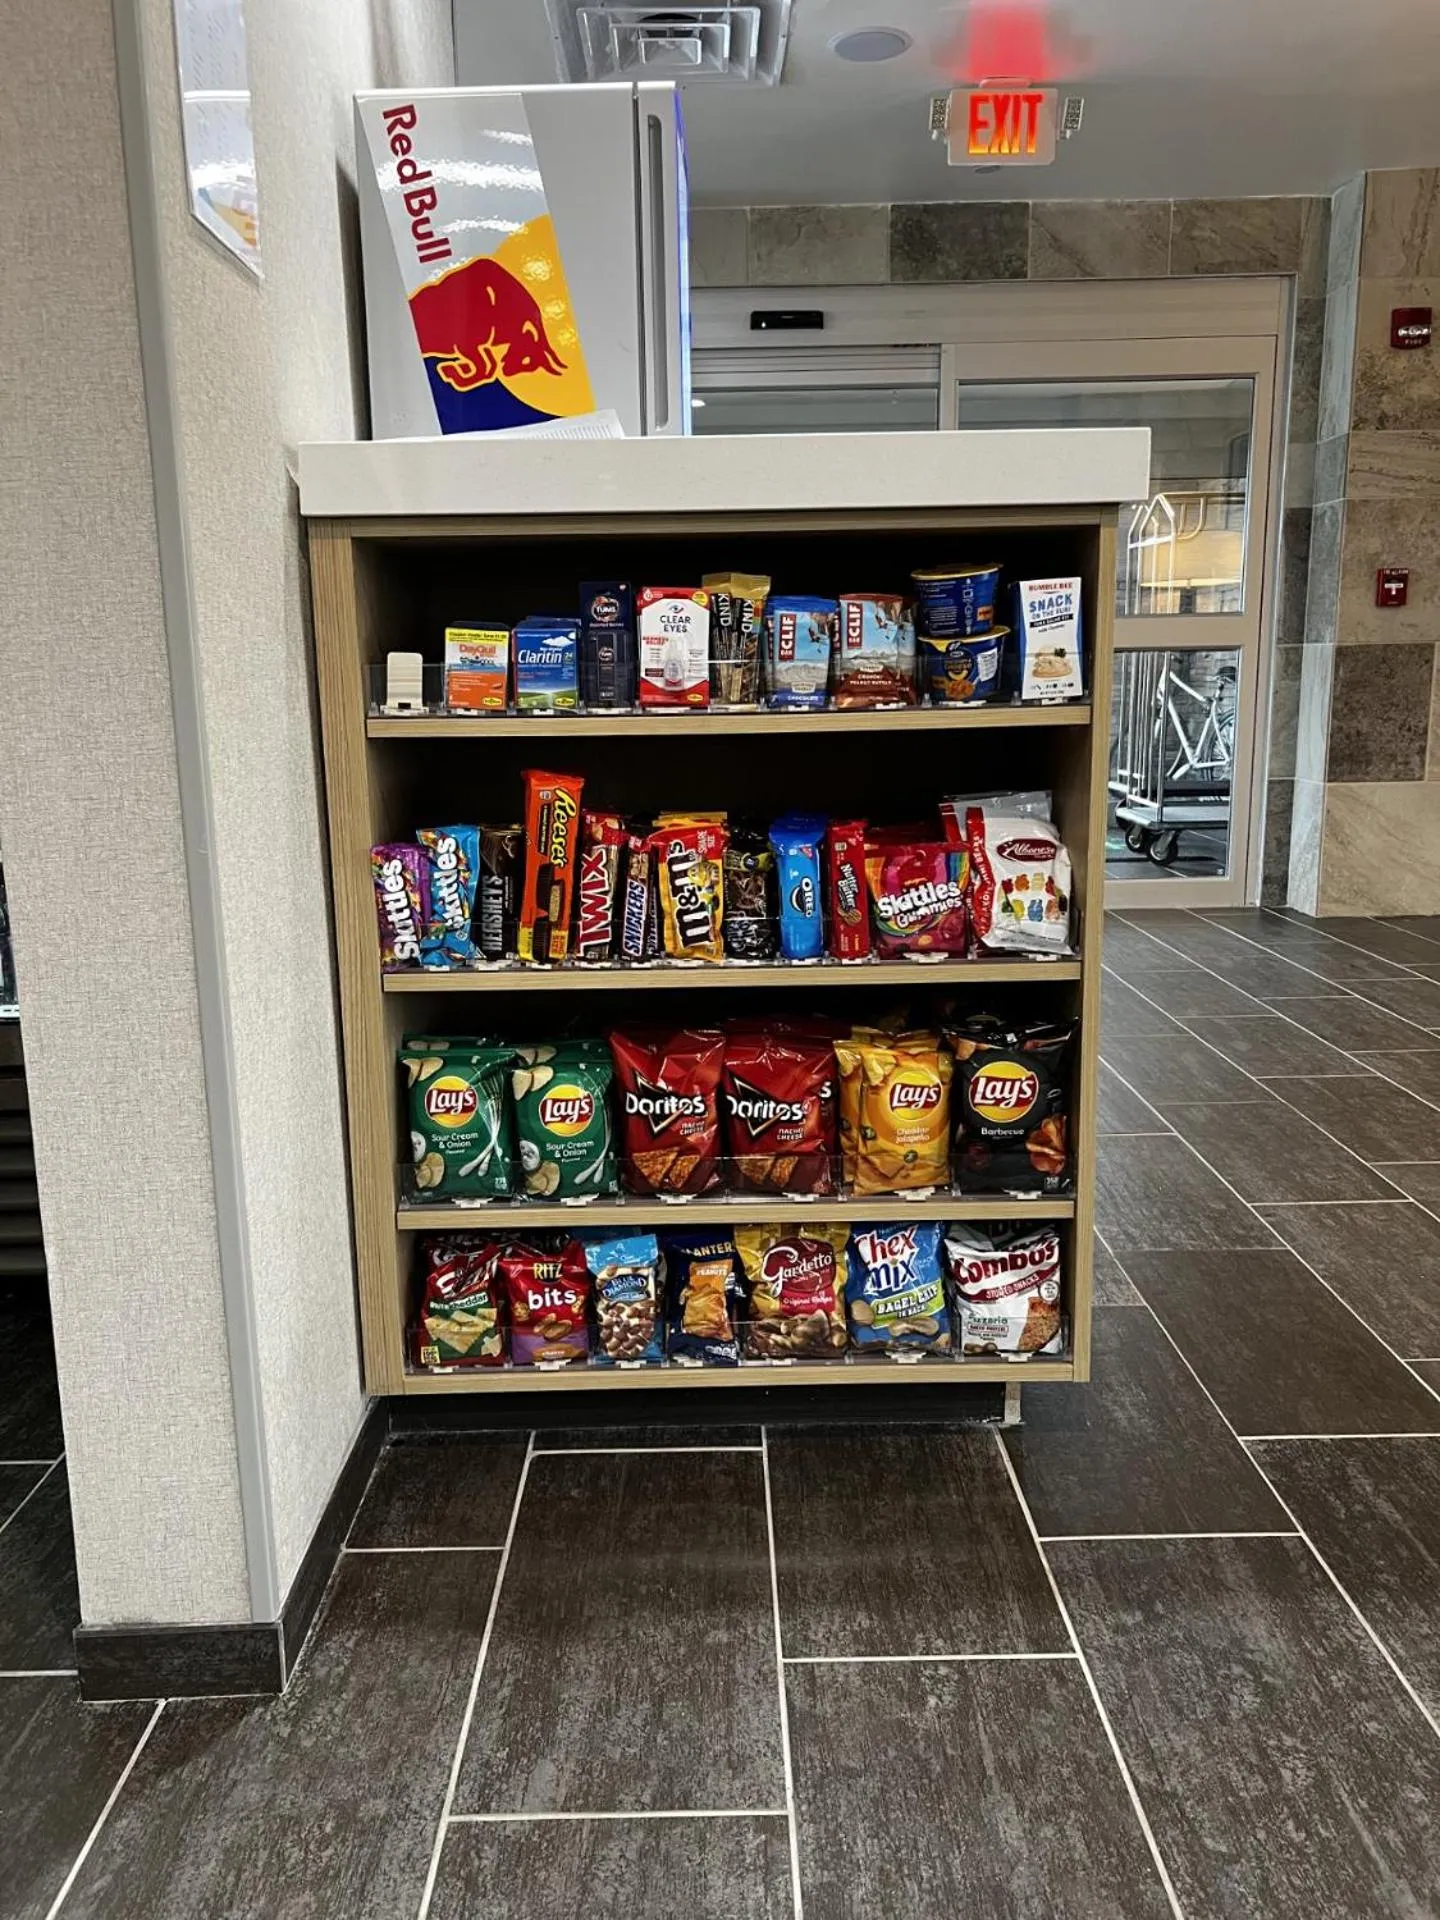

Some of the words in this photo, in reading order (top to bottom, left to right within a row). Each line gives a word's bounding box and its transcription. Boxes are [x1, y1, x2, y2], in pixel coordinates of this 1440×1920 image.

[968, 93, 1044, 155] EXIT
[382, 104, 433, 185] Red
[403, 186, 453, 264] Bull
[718, 592, 732, 627] KIND
[741, 599, 753, 633] KIND
[1029, 593, 1073, 612] SNACK
[659, 615, 692, 624] CLEAR
[663, 624, 688, 633] EYES
[780, 615, 795, 648] CLIF
[848, 603, 863, 636] CLIF
[517, 649, 563, 664] Claritin
[551, 787, 578, 867] Reese's
[433, 837, 466, 929] Skittles
[841, 864, 858, 894] Nutter
[381, 858, 421, 961] Skittles
[579, 846, 613, 957] TWIX
[801, 877, 814, 918] OREO
[838, 879, 856, 911] Butter
[877, 881, 961, 918] Skittles
[481, 874, 503, 951] HERSHEY'S
[624, 880, 647, 955] SNICKERS
[896, 897, 963, 928] Gummies
[429, 1089, 475, 1114] Lay's
[625, 1092, 706, 1116] Doritos
[725, 1095, 803, 1120] Doritos
[892, 1081, 940, 1109] Lay's
[973, 1076, 1034, 1110] Lay's
[544, 1097, 593, 1124] Lay's
[431, 1134, 449, 1142] Sour
[451, 1131, 479, 1141] Cream
[446, 1140, 472, 1149] Onion
[545, 1143, 565, 1151] Sour
[566, 1140, 595, 1149] Cream
[981, 1127, 1025, 1136] Barbecue
[554, 1150, 561, 1158] &
[562, 1148, 587, 1157] Onion
[533, 1262, 563, 1280] RITZ
[528, 1288, 577, 1311] bits
[602, 1277, 647, 1297] DIAMOND
[877, 1295, 916, 1314] BAGEL
